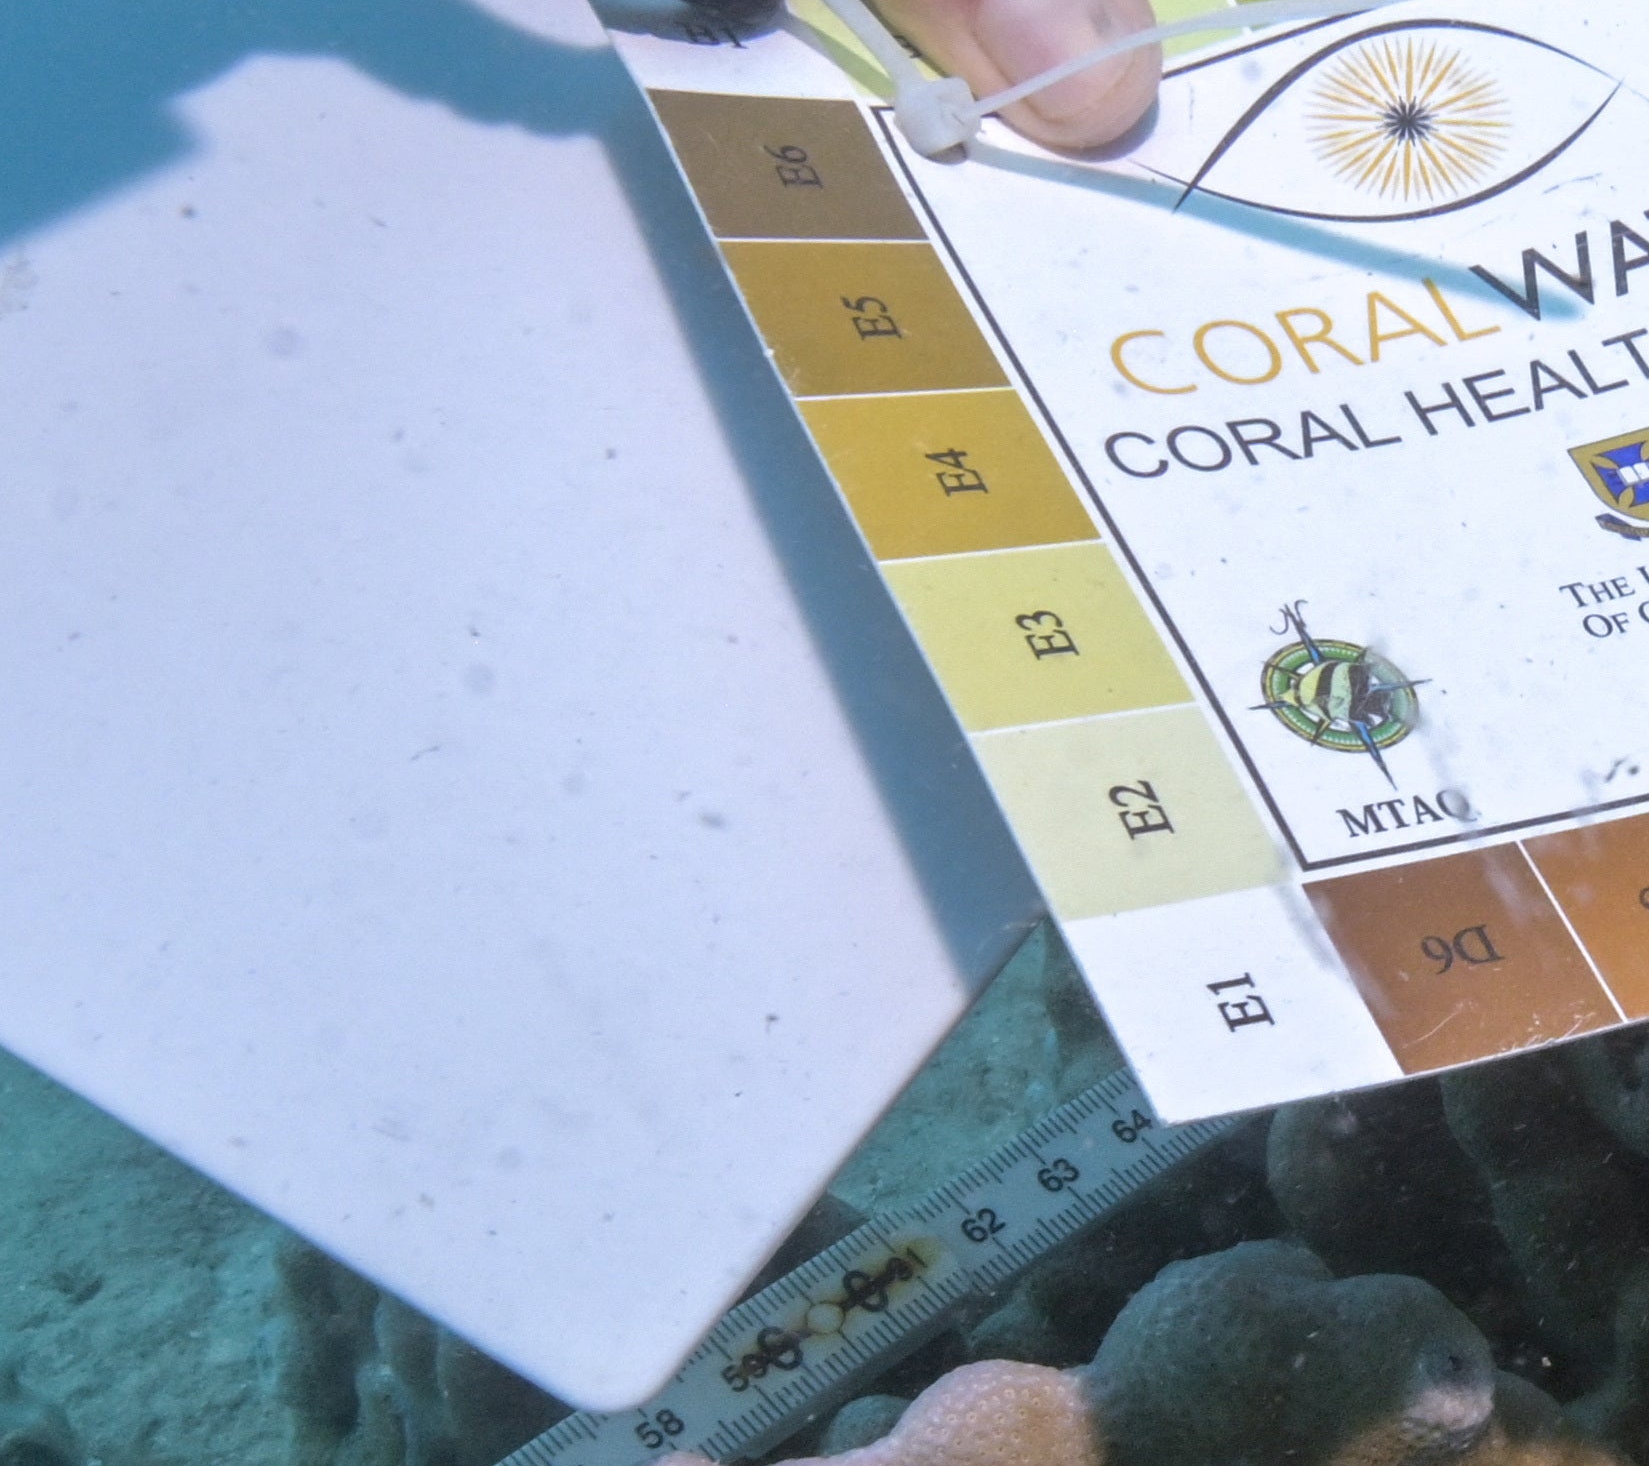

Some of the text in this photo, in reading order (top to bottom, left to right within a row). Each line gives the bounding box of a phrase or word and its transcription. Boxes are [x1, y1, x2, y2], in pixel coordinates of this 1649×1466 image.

[764, 143, 824, 190] E6
[842, 294, 903, 341] E5
[1105, 402, 1401, 479] CORAL
[925, 447, 990, 496] E4
[1559, 576, 1636, 609] THE
[1016, 609, 1080, 660] E3
[1583, 611, 1630, 639] OF
[1108, 780, 1176, 840] E2
[1421, 926, 1505, 974] D6
[1207, 972, 1276, 1032] E1
[635, 1408, 684, 1449] 58
[960, 1207, 1007, 1242] 62
[1037, 1156, 1080, 1192] 63
[1111, 1110, 1152, 1144] 64
